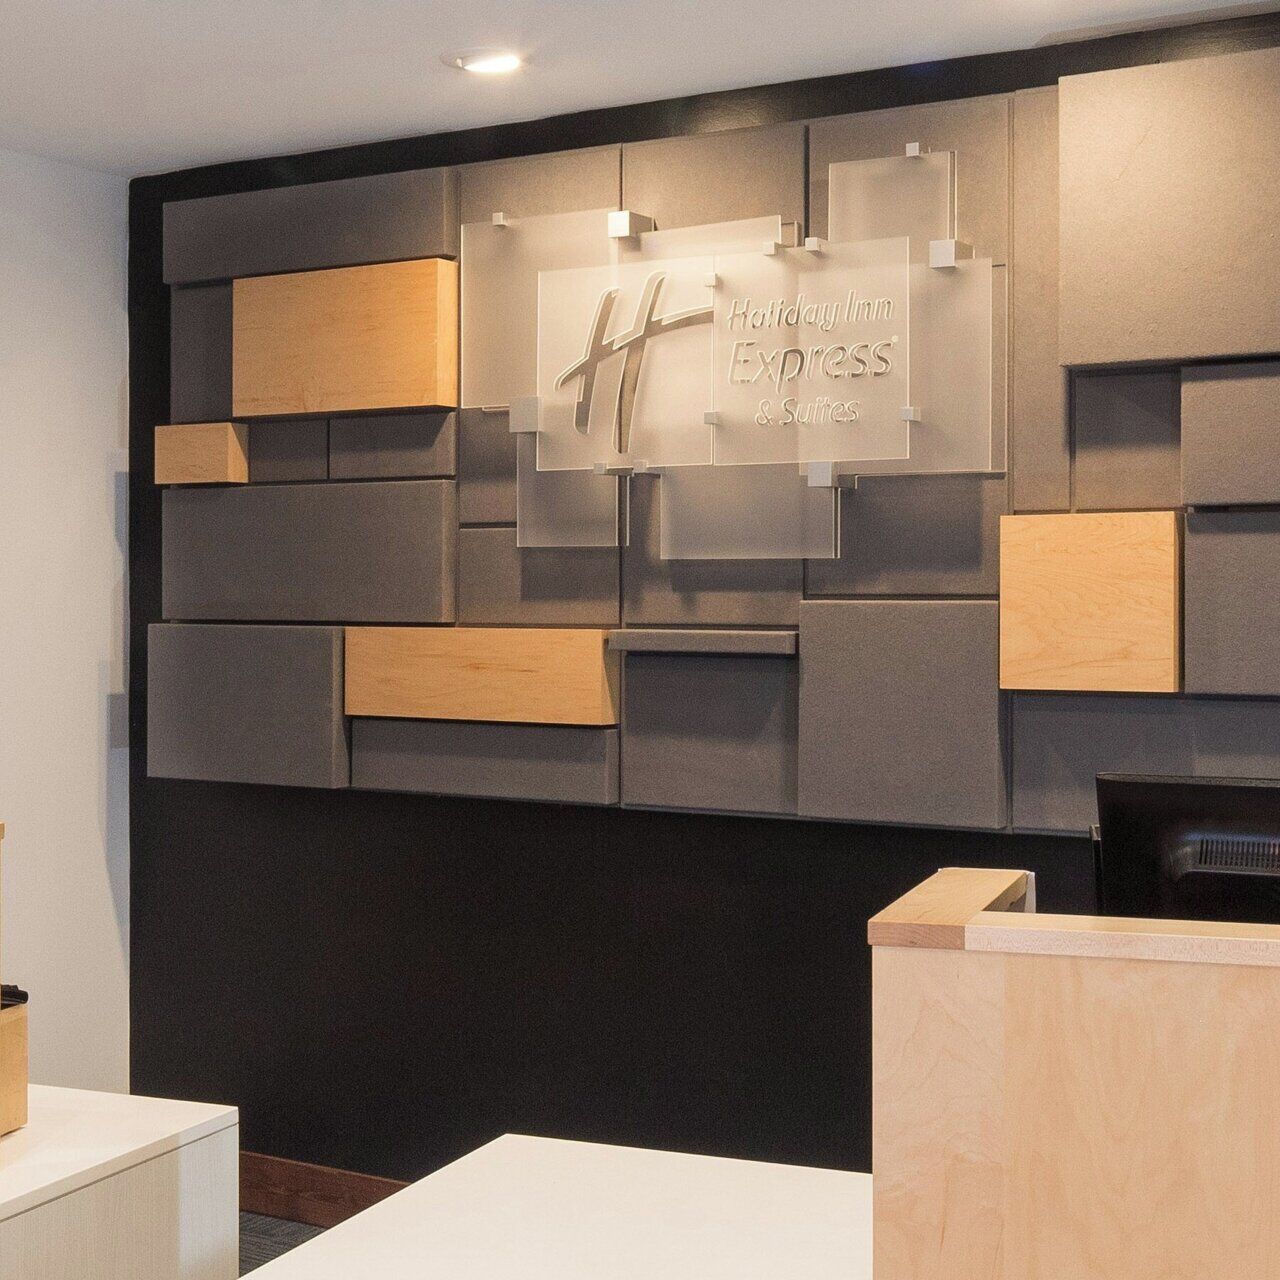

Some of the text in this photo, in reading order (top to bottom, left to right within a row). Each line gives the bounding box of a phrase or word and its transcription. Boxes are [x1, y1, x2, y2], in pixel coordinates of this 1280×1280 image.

[727, 289, 894, 332] Holiday Inn
[728, 340, 894, 395] Express
[755, 397, 860, 426] & Suites
